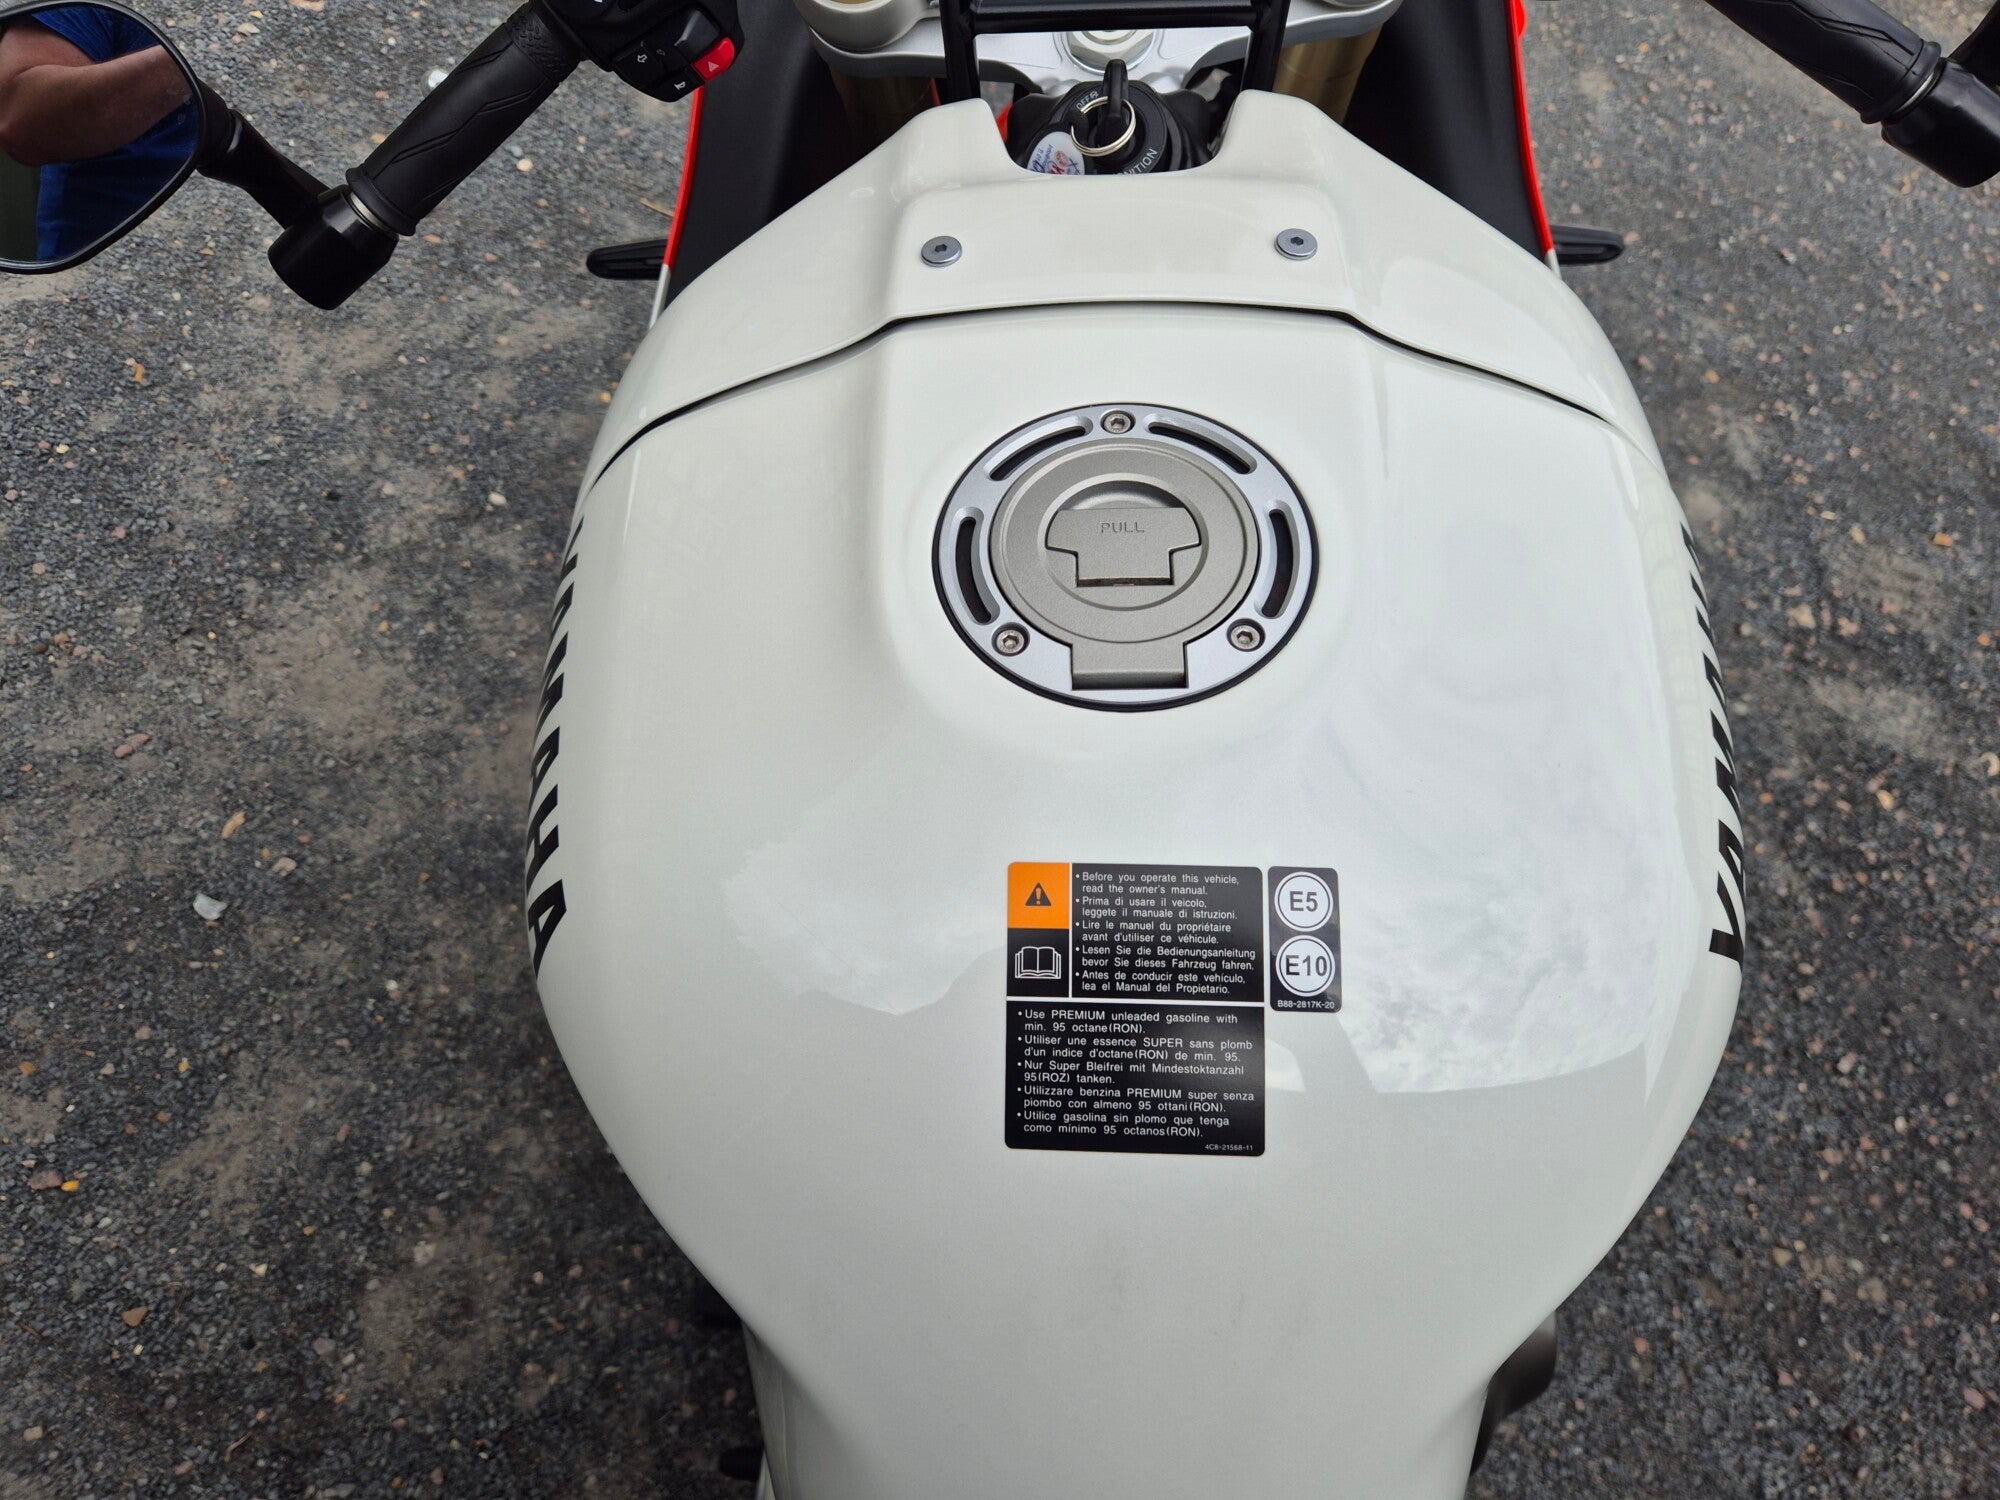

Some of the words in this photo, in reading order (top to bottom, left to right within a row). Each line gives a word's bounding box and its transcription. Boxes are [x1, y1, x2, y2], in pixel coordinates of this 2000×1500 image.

[1076, 95, 1090, 110] OFF
[1101, 521, 1145, 534] PULL
[1082, 871, 1113, 881] Before
[1118, 874, 1135, 884] you
[1140, 874, 1176, 884] operate
[1182, 874, 1199, 883] this
[1204, 874, 1239, 885] vehicle,
[1082, 884, 1103, 893] read
[1109, 884, 1124, 893] the
[1129, 885, 1165, 894] owner's
[1171, 886, 1207, 895] manual.
[1082, 896, 1110, 906] Prima
[1115, 896, 1124, 906] di
[1129, 899, 1155, 907] usare
[1161, 897, 1166, 906] il
[1172, 898, 1207, 908] veicolo,
[1289, 891, 1318, 912] E5
[1082, 907, 1117, 919] leggete
[1122, 908, 1128, 917] il
[1133, 908, 1173, 918] manuale
[1178, 909, 1187, 918] di
[1193, 909, 1237, 919] istruzioni.
[1082, 920, 1100, 930] Lire
[1105, 920, 1114, 930] le
[1119, 921, 1154, 931] manuel
[1159, 921, 1171, 931] du
[1177, 922, 1231, 933] propriétaire
[1082, 933, 1108, 941] avant
[1114, 932, 1155, 942] d'utiliser
[1160, 935, 1172, 943] ce
[1178, 933, 1219, 944] véhicule.
[1082, 944, 1111, 955] Lesen
[1116, 944, 1131, 955] Sie
[1136, 946, 1152, 956] die
[1157, 946, 1256, 960] Bedienungsanleitung
[1082, 956, 1109, 967] bevor
[1114, 957, 1130, 967] Sie
[1135, 958, 1166, 968] dieses
[1172, 958, 1217, 972] Fahrzeug
[1221, 959, 1254, 970] fahren.
[1286, 955, 1328, 977] E10
[1082, 969, 1109, 980] Antes
[1114, 970, 1127, 980] de
[1131, 971, 1173, 981] conducir
[1178, 973, 1198, 982] este
[1082, 981, 1096, 991] lea
[1101, 981, 1110, 991] el
[1116, 981, 1151, 992] Manual
[1156, 983, 1170, 992] del
[1176, 982, 1230, 995] Propietario.
[1025, 1009, 1045, 1019] Use
[1051, 1009, 1105, 1020] PREMIUM
[1111, 1011, 1160, 1022] unleaded
[1165, 1013, 1210, 1025] gasoline
[1216, 1014, 1238, 1023] with
[1024, 1021, 1046, 1031] min.
[1052, 1021, 1066, 1032] 95
[1024, 1034, 1061, 1045] Utiliser
[1067, 1037, 1087, 1046] une
[1093, 1038, 1137, 1047] essence
[1143, 1037, 1183, 1048] SUPER
[1189, 1040, 1214, 1049] sans
[1220, 1039, 1253, 1051] plomb
[1024, 1046, 1046, 1057] d'un
[1052, 1047, 1083, 1058] indice
[1174, 1050, 1188, 1060] de
[1194, 1051, 1216, 1061] min.
[1225, 1052, 1240, 1062] 95.
[1024, 1059, 1043, 1070] Nur
[1049, 1060, 1080, 1073] Super
[1086, 1061, 1123, 1072] Bleifrei
[1129, 1063, 1146, 1072] mit
[1152, 1063, 1244, 1075] Mindestoktanzahl
[1076, 1074, 1115, 1084] tanken.
[1024, 1085, 1074, 1096] Utilizzare
[1079, 1086, 1121, 1097] benzina
[1127, 1087, 1182, 1099] PREMIUM
[1188, 1091, 1218, 1102] super
[1223, 1092, 1254, 1101] senza
[1024, 1097, 1062, 1109] piombo
[1068, 1100, 1087, 1109] con
[1093, 1099, 1132, 1110] almeno
[1138, 1100, 1152, 1111] 95
[1024, 1110, 1057, 1121] Utilice
[1063, 1112, 1107, 1124] gasolina
[1113, 1113, 1129, 1123] sin
[1134, 1113, 1167, 1125] plomo
[1173, 1116, 1193, 1126] que
[1199, 1116, 1230, 1128] tenga
[1023, 1124, 1052, 1133] como
[1058, 1124, 1097, 1134] mínimo
[1103, 1125, 1117, 1135] 95
